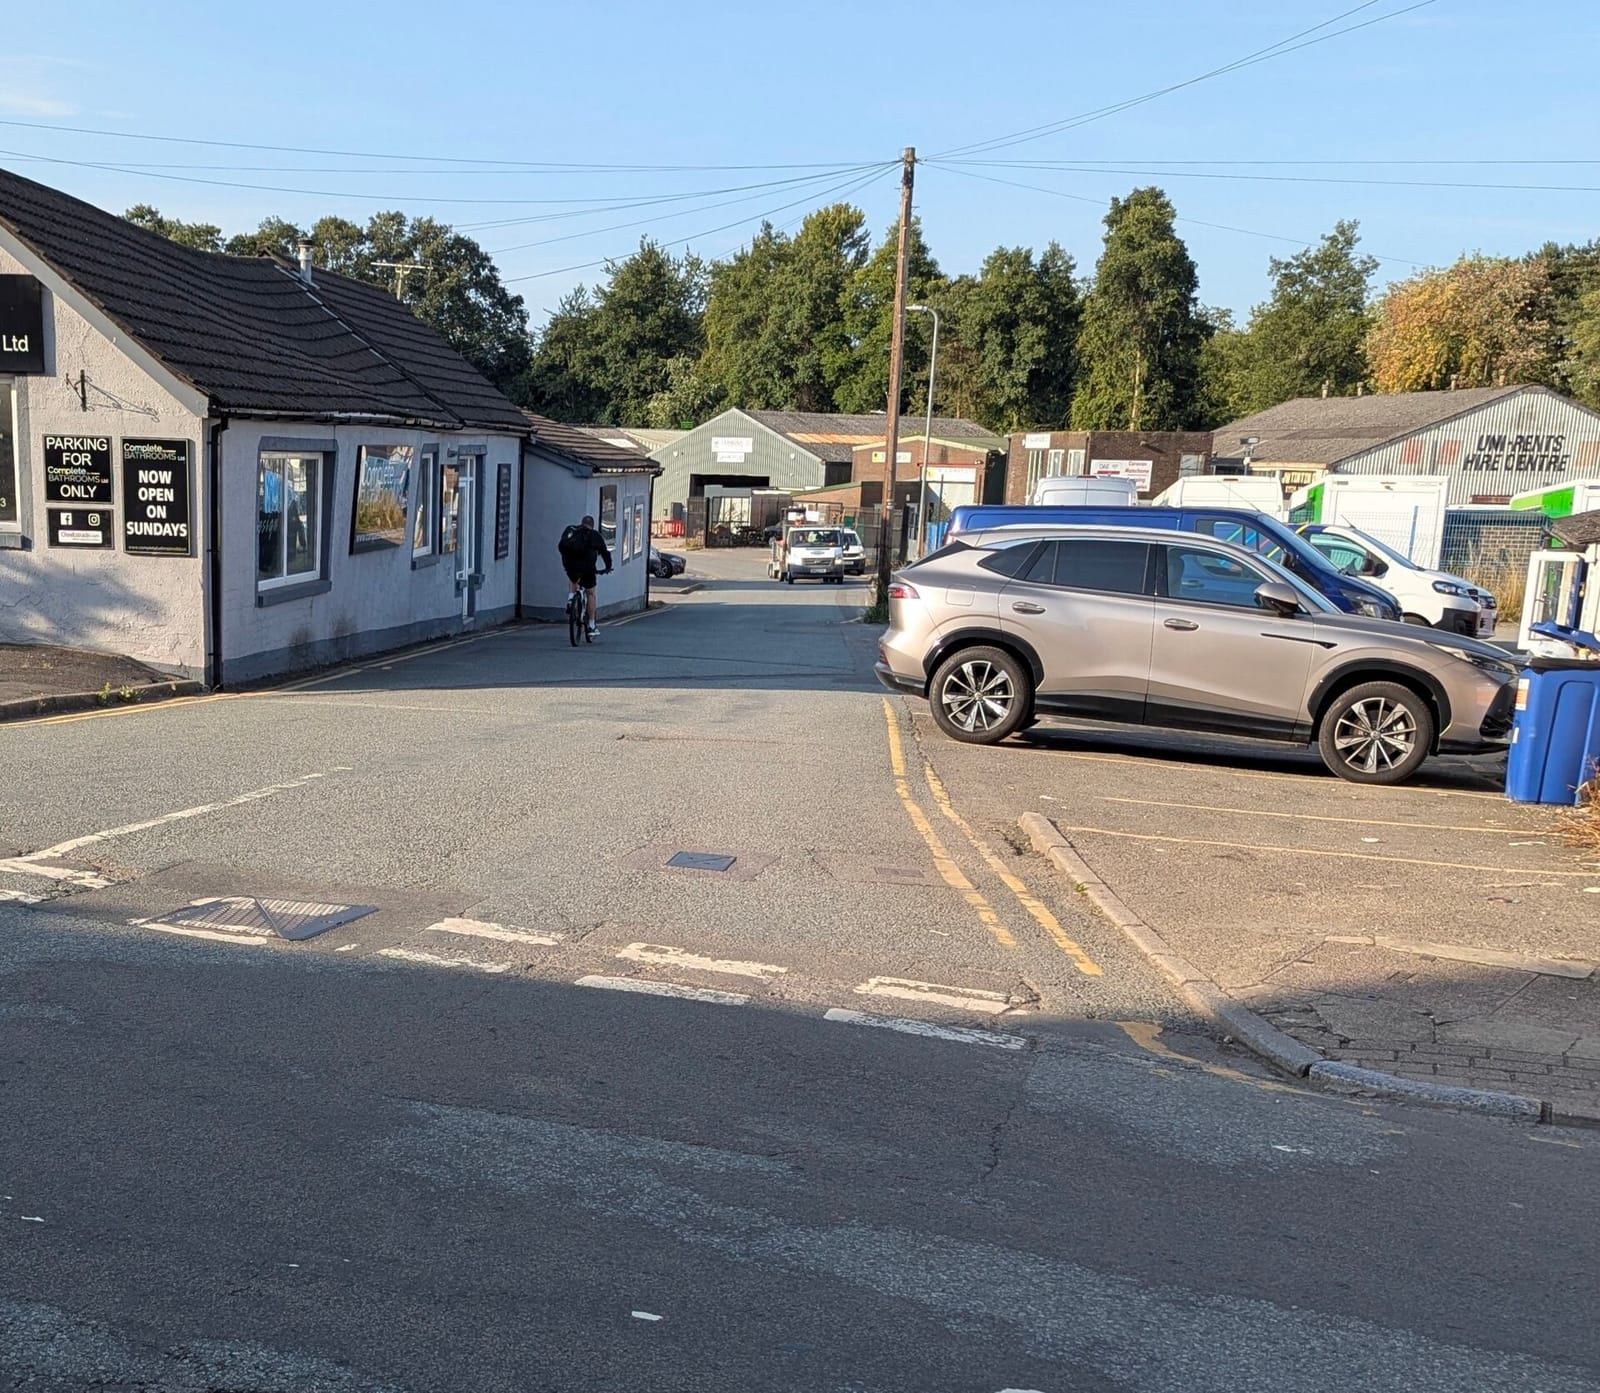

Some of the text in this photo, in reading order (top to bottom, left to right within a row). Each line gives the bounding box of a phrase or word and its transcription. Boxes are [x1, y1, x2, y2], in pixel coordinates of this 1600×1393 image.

[2, 334, 29, 352] Ltd
[46, 437, 108, 451] PARKING
[123, 442, 163, 454] Complete
[63, 452, 92, 466] FOR
[124, 451, 177, 461] BATHROOMS
[1462, 454, 1570, 472] HIRE CENTRE
[47, 466, 87, 475] Complete
[138, 469, 172, 484] NOW
[48, 474, 101, 483] BATHROOMS
[60, 484, 97, 498] ONLY
[138, 487, 174, 502] OPEN
[146, 504, 167, 519] ON
[126, 521, 187, 537] SUNDAYS
